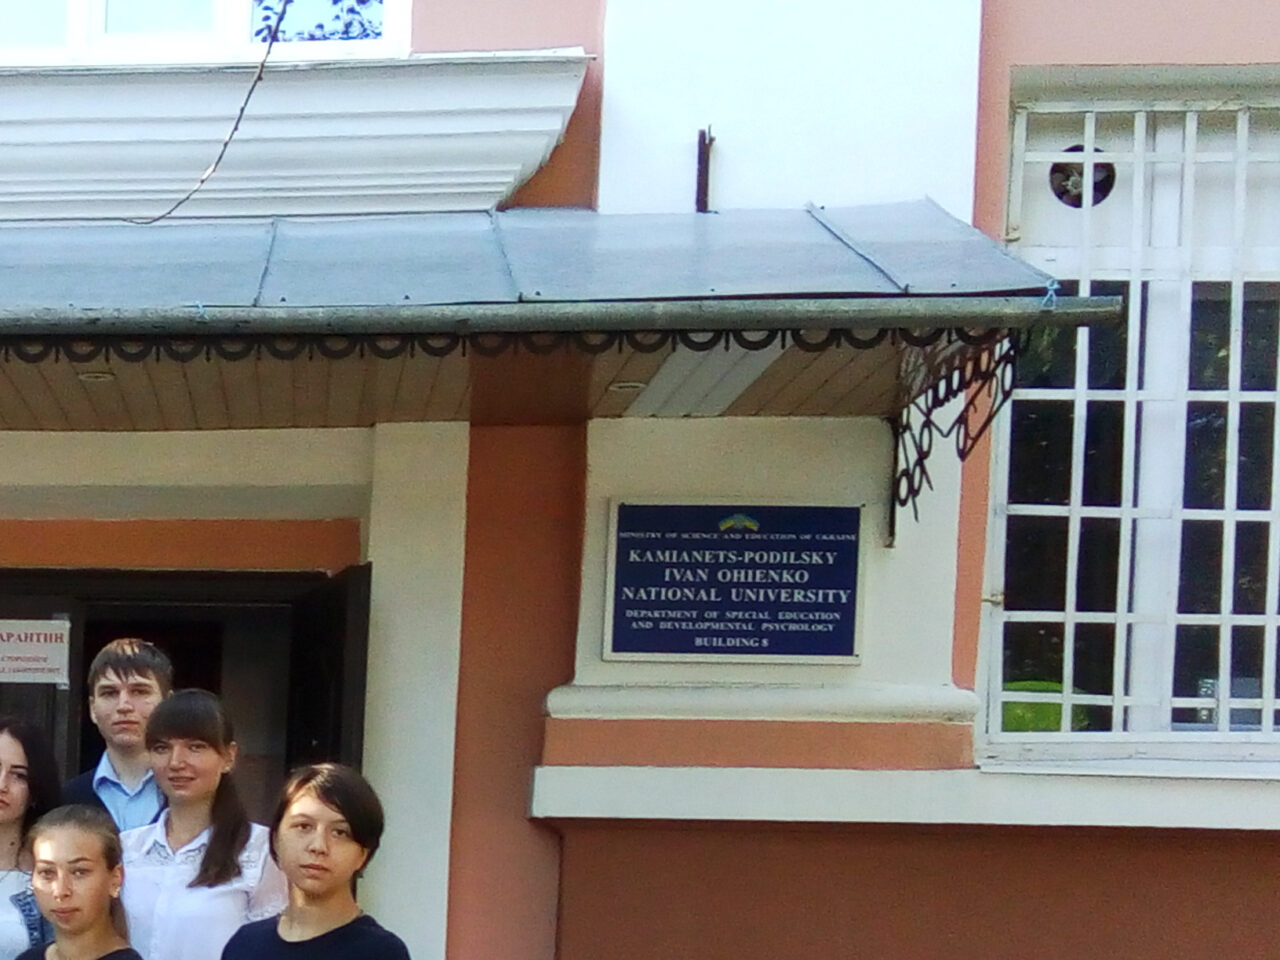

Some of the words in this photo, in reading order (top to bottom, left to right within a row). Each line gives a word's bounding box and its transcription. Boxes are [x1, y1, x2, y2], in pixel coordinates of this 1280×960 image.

[628, 550, 838, 565] KAMIANETS-PODILSKY
[664, 568, 710, 582] IVAN
[717, 569, 809, 583] OHIENKO
[621, 587, 722, 601] NATIONAL
[731, 588, 851, 604] UNIVERSITY
[625, 609, 698, 619] DEPARTMENT
[704, 610, 719, 619] OF
[725, 610, 771, 620] SPECIAL
[778, 611, 841, 620] EDUCATION
[631, 621, 653, 629] AND
[659, 621, 754, 630] DEVELOPMENTAL
[761, 622, 835, 632] PSYCHOLOGY
[694, 637, 760, 647] BUILDING
